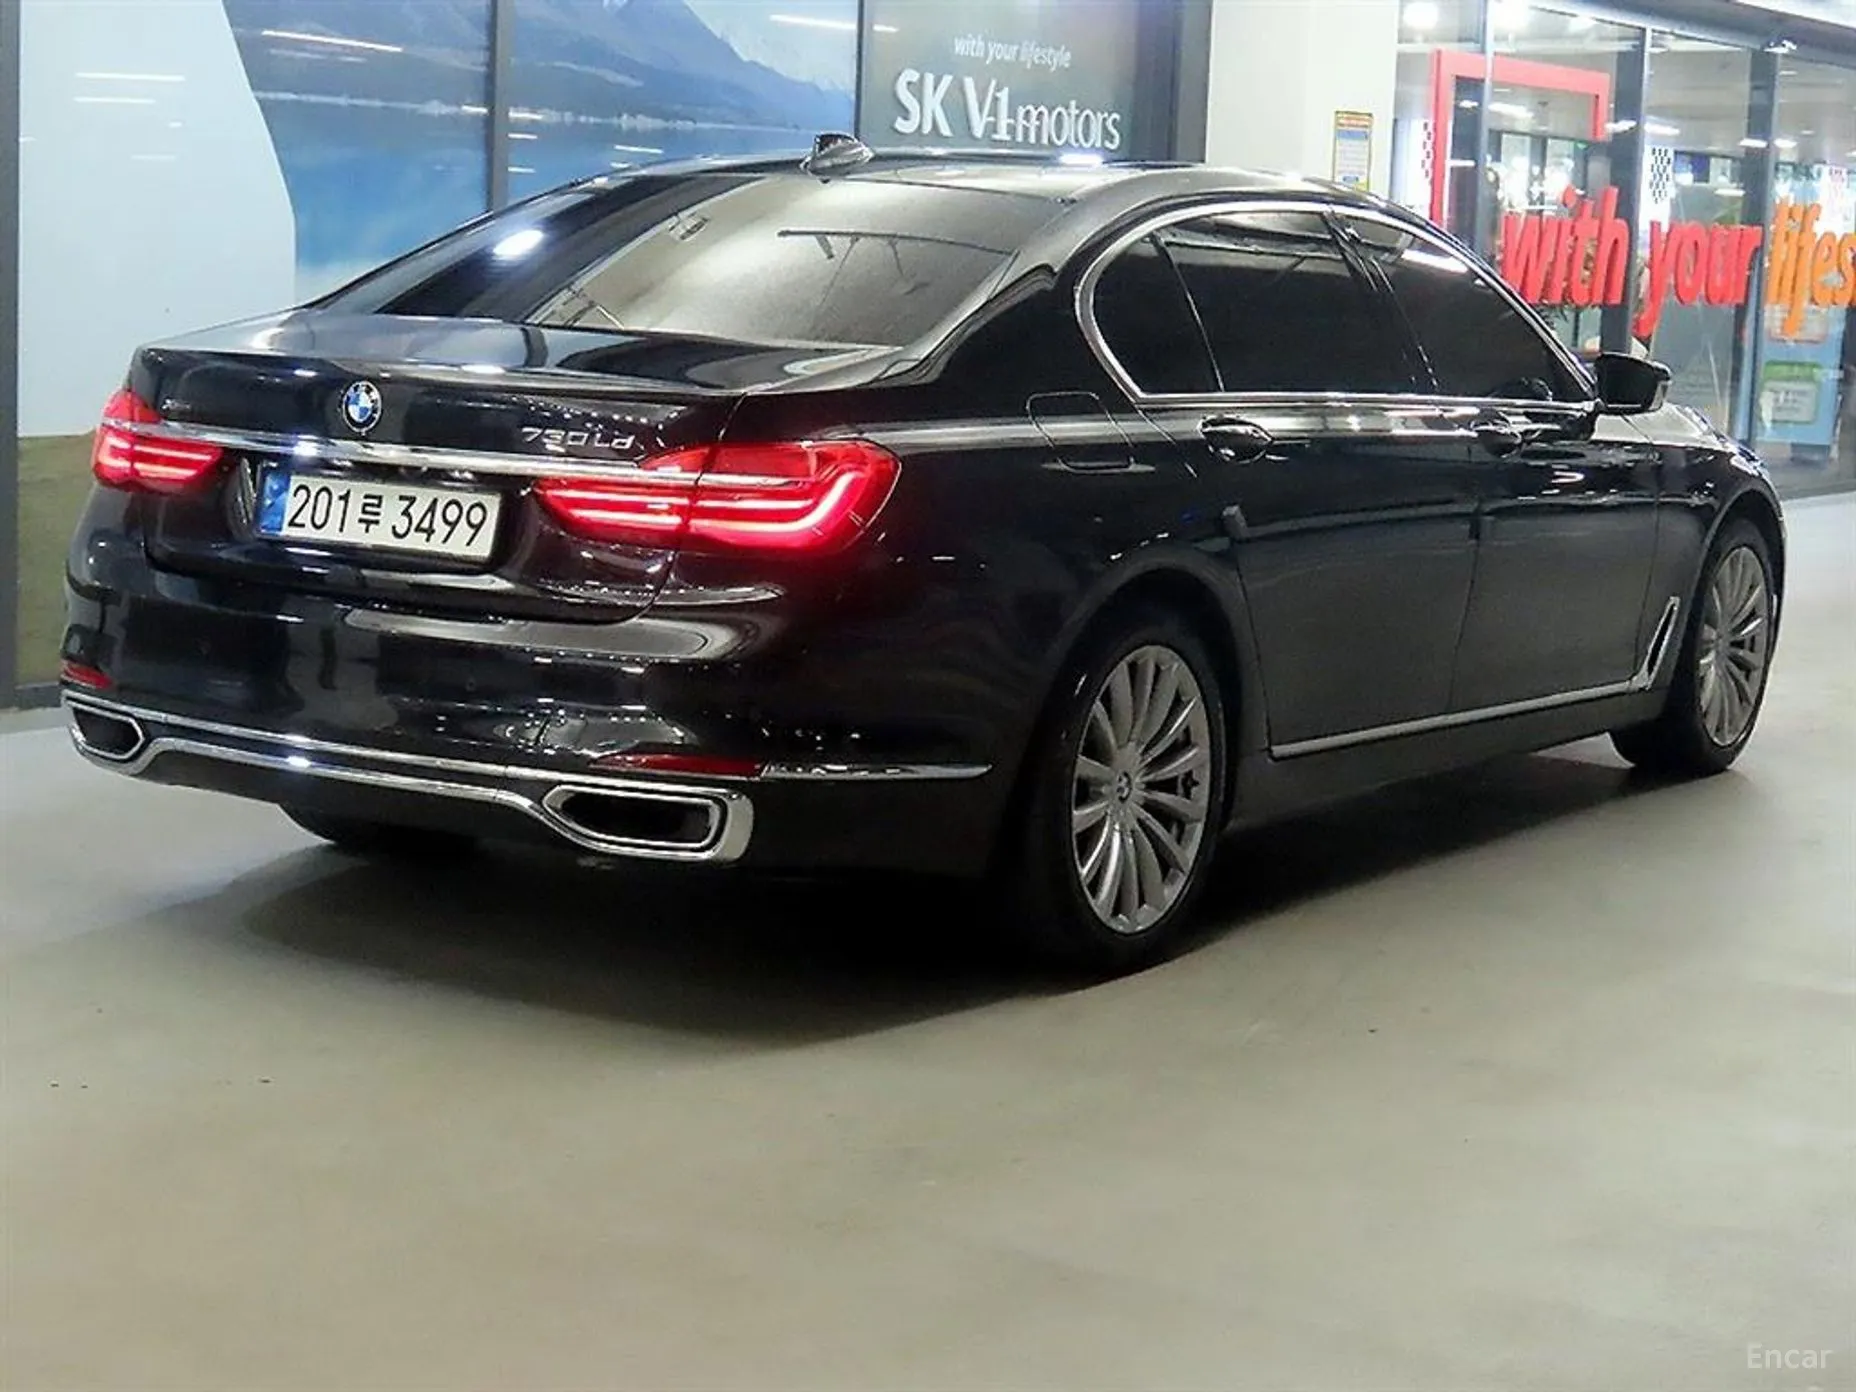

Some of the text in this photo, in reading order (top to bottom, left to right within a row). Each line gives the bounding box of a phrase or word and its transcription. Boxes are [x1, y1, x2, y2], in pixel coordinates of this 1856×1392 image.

[954, 34, 1071, 72] with your lifestyle
[894, 68, 953, 137] SK
[1502, 184, 1630, 305] with
[1634, 219, 1763, 338] your
[288, 483, 488, 547] 201루 3499
